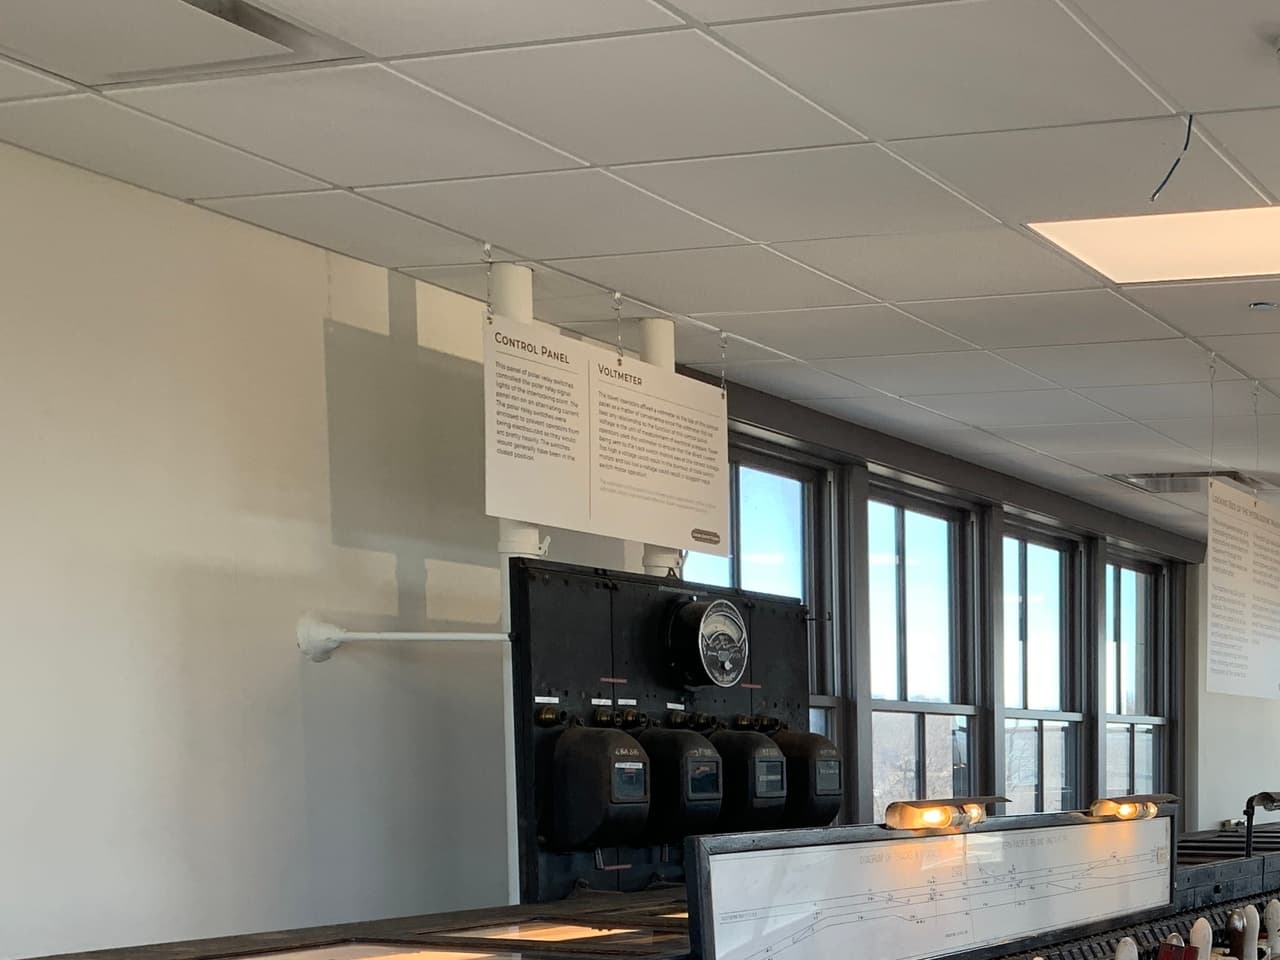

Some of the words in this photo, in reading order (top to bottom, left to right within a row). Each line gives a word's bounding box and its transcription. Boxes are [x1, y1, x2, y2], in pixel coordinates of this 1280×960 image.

[495, 332, 538, 355] CONTROL
[542, 346, 570, 364] PANEL
[598, 364, 642, 386] VOLTMETER
